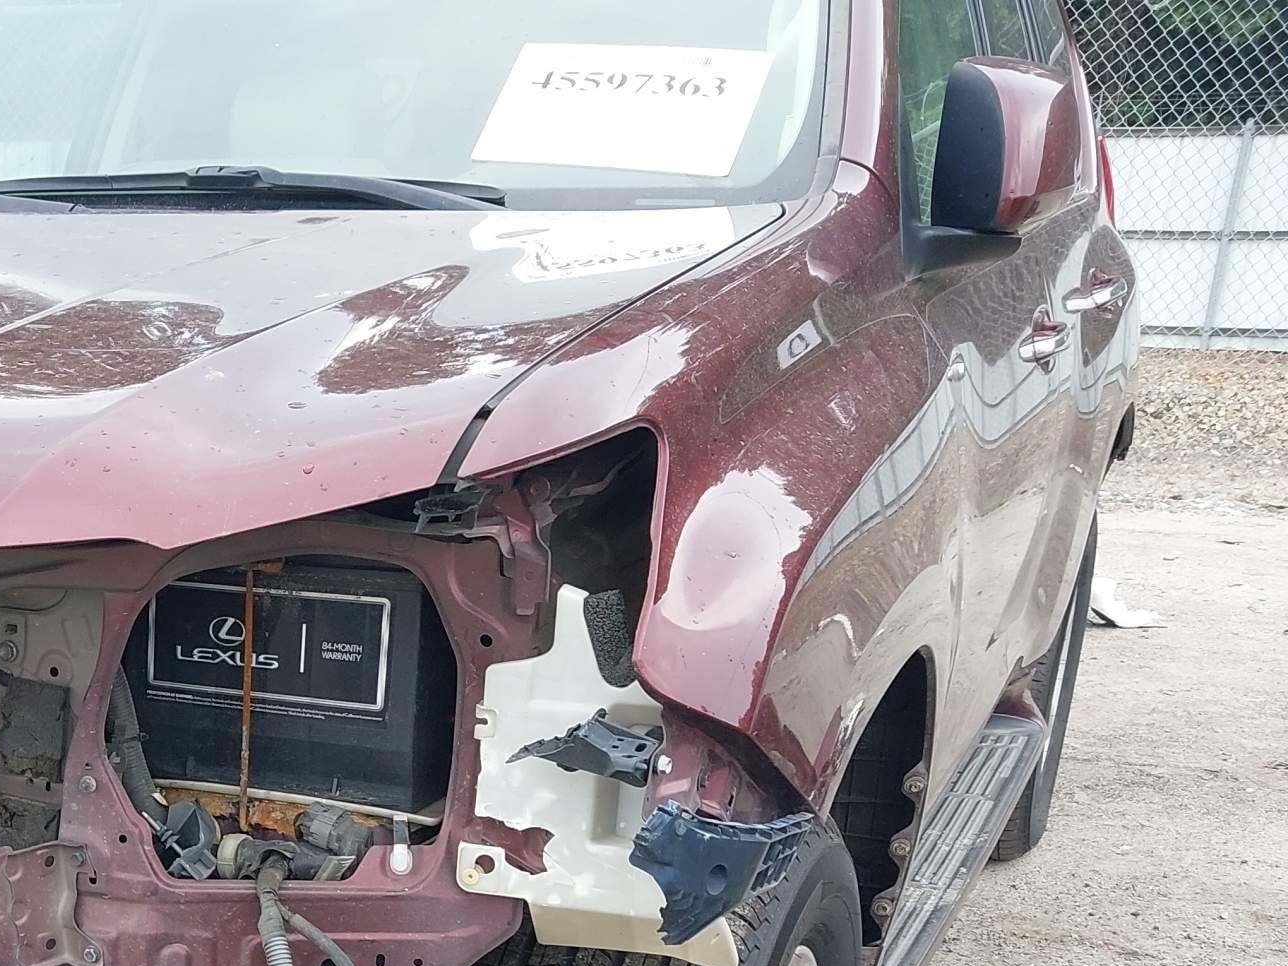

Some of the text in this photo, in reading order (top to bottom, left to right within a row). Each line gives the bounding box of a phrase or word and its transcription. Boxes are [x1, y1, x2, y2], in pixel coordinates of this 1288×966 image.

[531, 70, 728, 99] 45597363
[321, 641, 363, 653] 84-MONTH
[321, 650, 363, 662] WARRANTY
[175, 644, 280, 670] LEXUS
